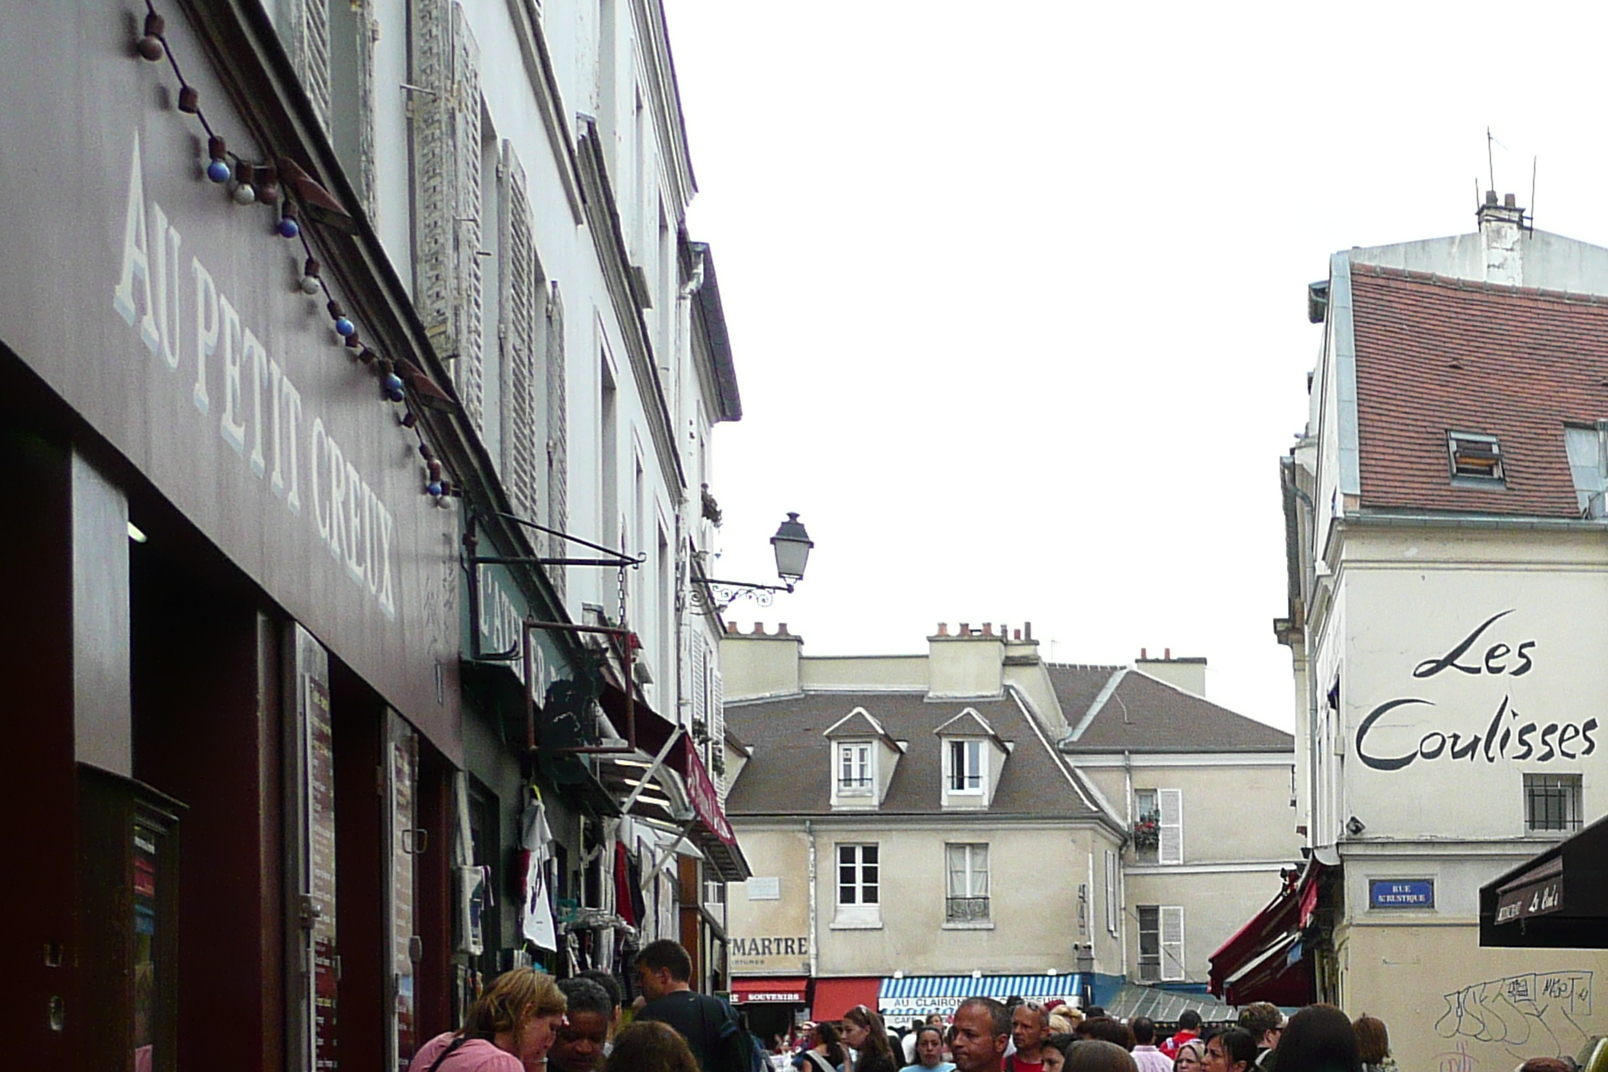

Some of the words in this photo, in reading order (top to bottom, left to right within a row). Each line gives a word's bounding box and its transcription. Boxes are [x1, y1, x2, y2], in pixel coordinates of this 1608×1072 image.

[114, 126, 181, 369] AU
[192, 256, 303, 516] PETIT
[312, 417, 396, 622] CREUX
[1412, 608, 1536, 678] Les
[1356, 694, 1599, 771] Coulisses
[1392, 885, 1411, 893] RUE
[730, 937, 808, 956] MARTRE
[748, 993, 799, 1001] SOUVENIRS
[894, 998, 909, 1007] AU
